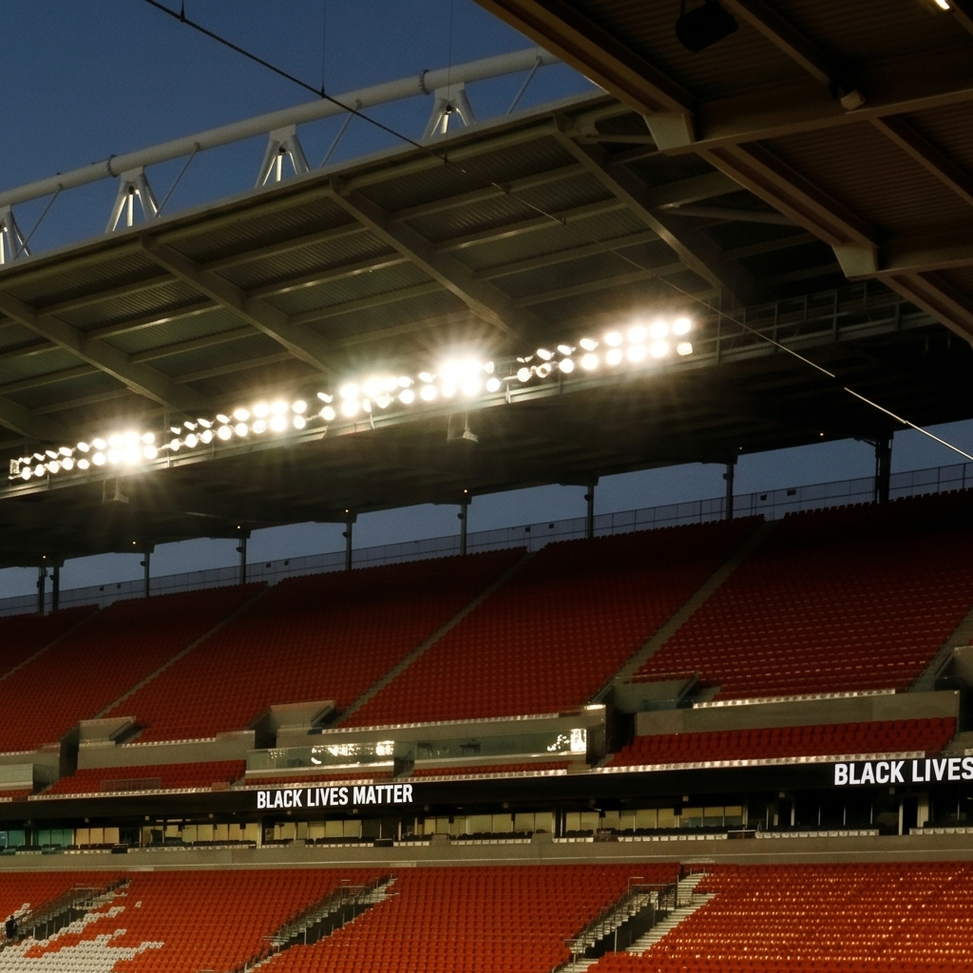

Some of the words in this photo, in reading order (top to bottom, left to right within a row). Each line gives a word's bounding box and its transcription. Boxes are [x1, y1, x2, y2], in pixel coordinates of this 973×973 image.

[834, 761, 905, 785] BLACK
[912, 757, 973, 782] LIVES
[257, 790, 302, 808] BLACK
[307, 788, 348, 806] LIVES
[353, 784, 413, 804] MATTER
